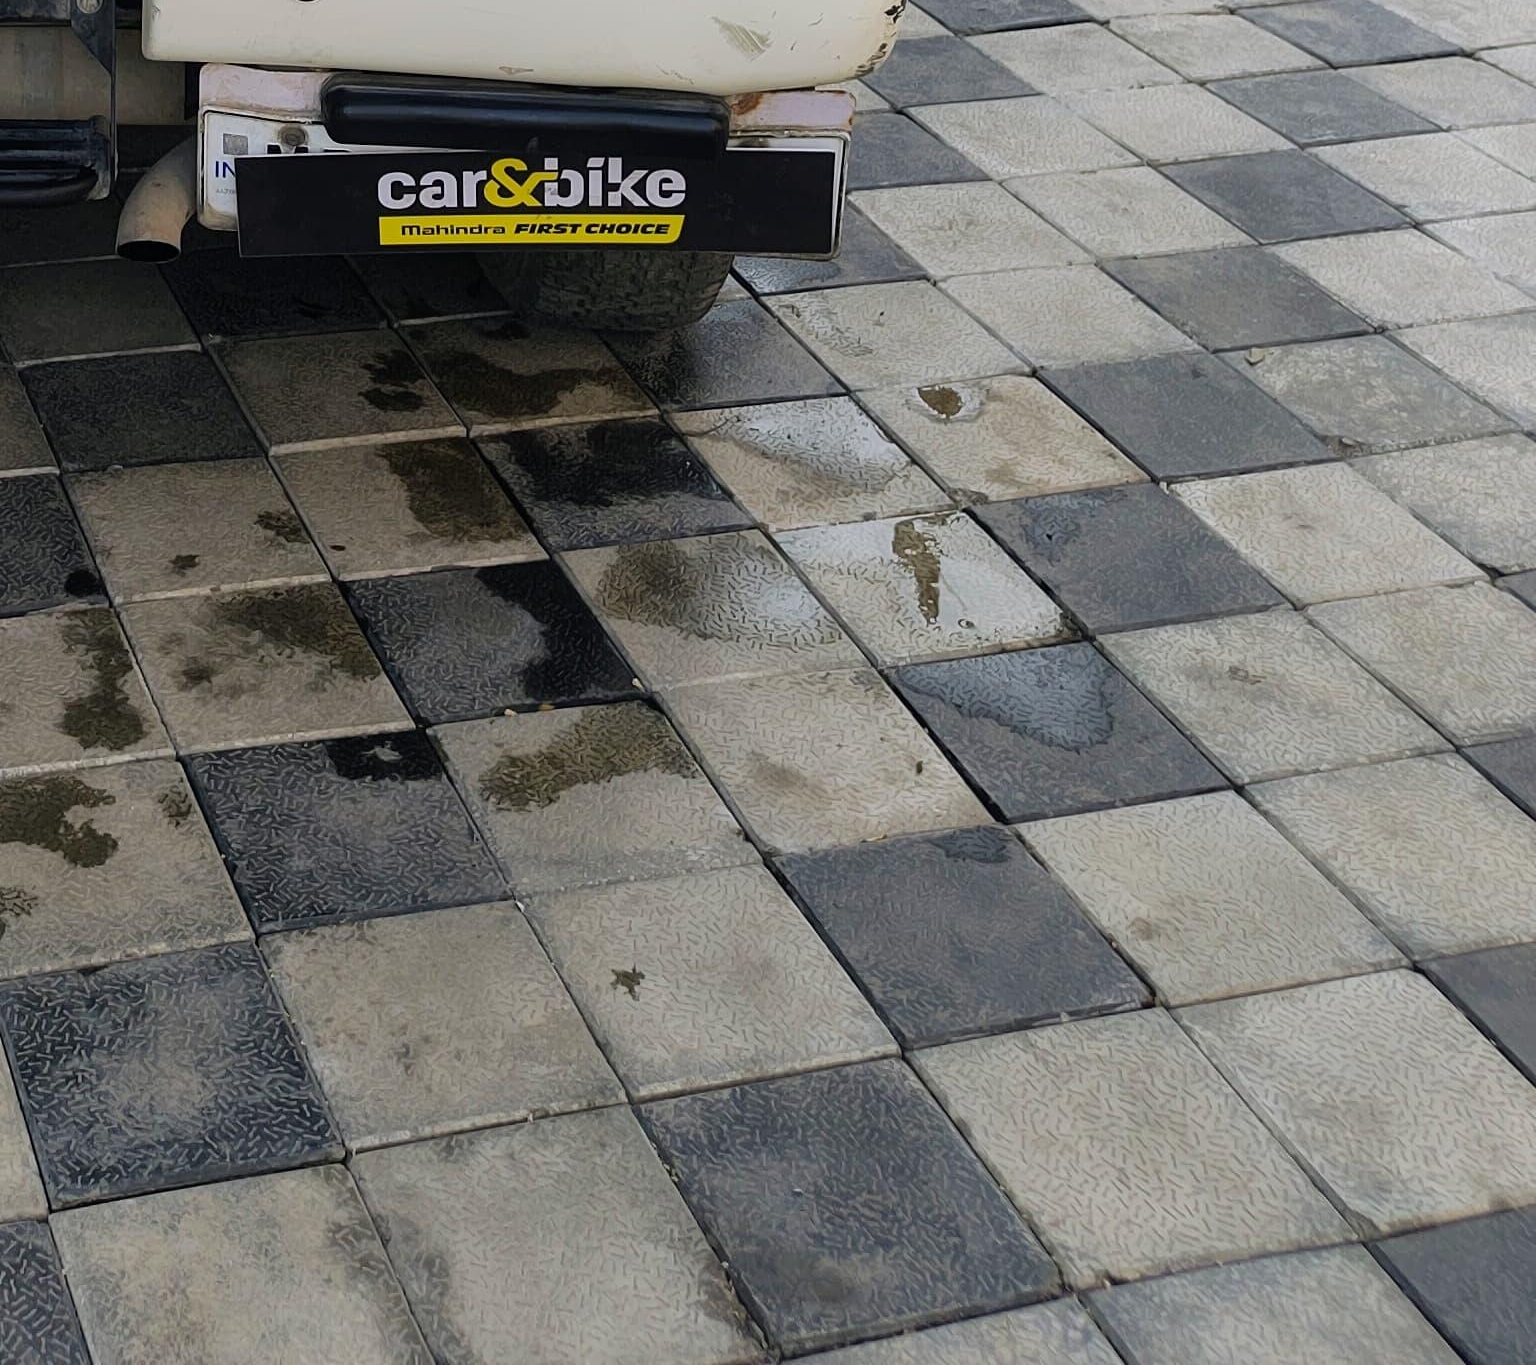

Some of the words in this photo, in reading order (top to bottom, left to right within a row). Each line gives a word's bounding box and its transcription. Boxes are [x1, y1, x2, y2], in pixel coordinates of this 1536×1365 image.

[215, 160, 236, 179] IN
[377, 156, 687, 210] car&bike
[400, 224, 506, 236] Mahindra
[514, 224, 583, 235] FIRST
[584, 223, 671, 235] CHOICE
